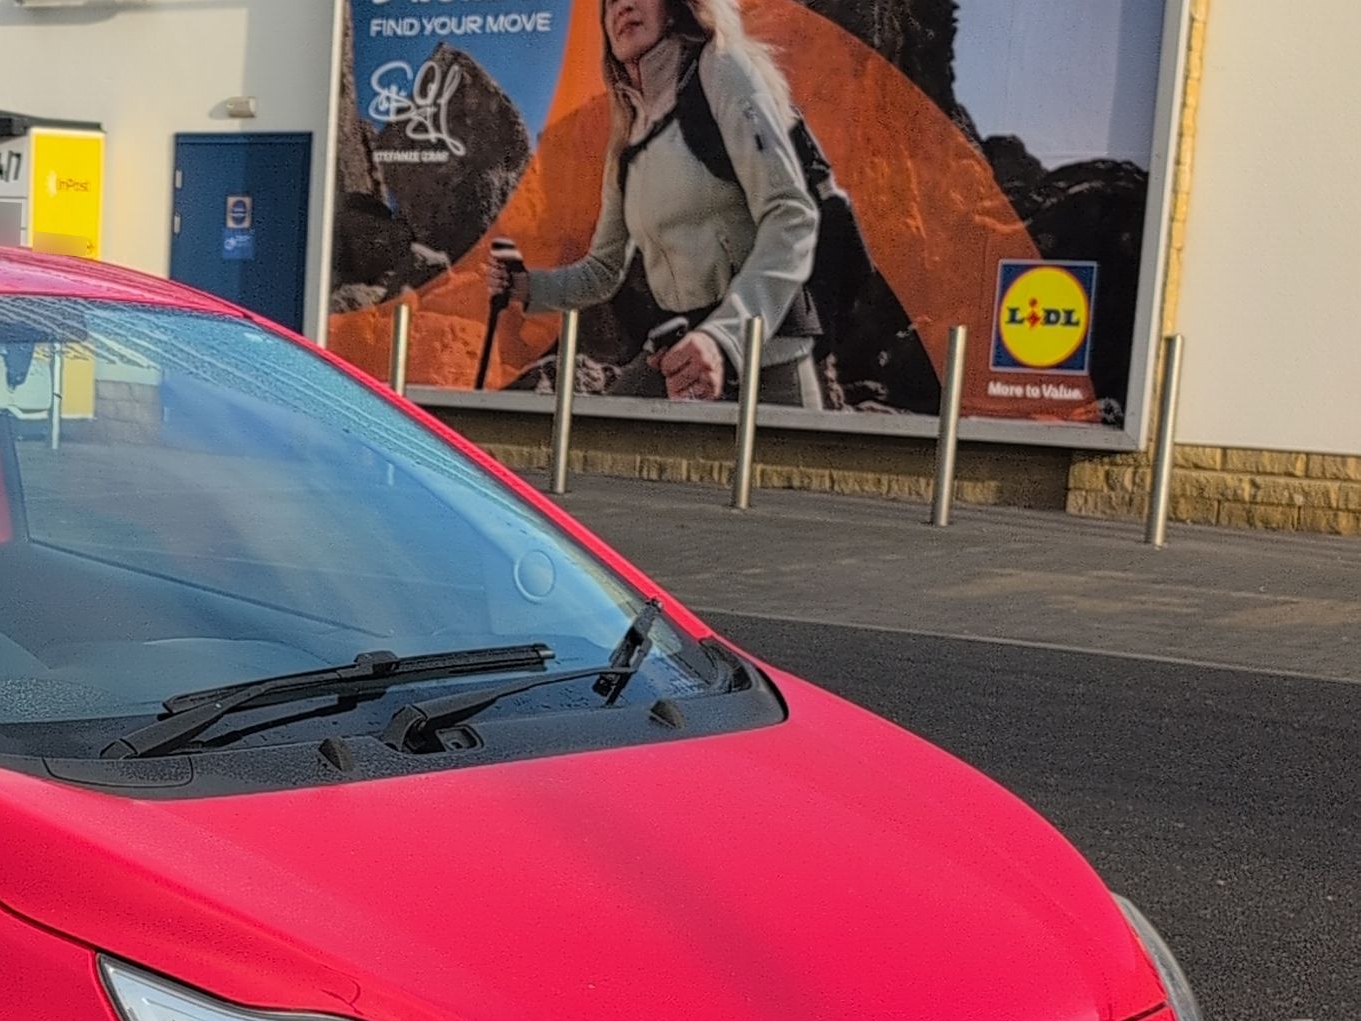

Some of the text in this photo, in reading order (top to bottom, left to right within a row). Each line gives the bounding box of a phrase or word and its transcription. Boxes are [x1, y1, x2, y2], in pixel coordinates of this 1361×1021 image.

[370, 12, 552, 37] FIND YOUR MOVE
[987, 381, 1025, 398] More
[1026, 384, 1039, 398] to
